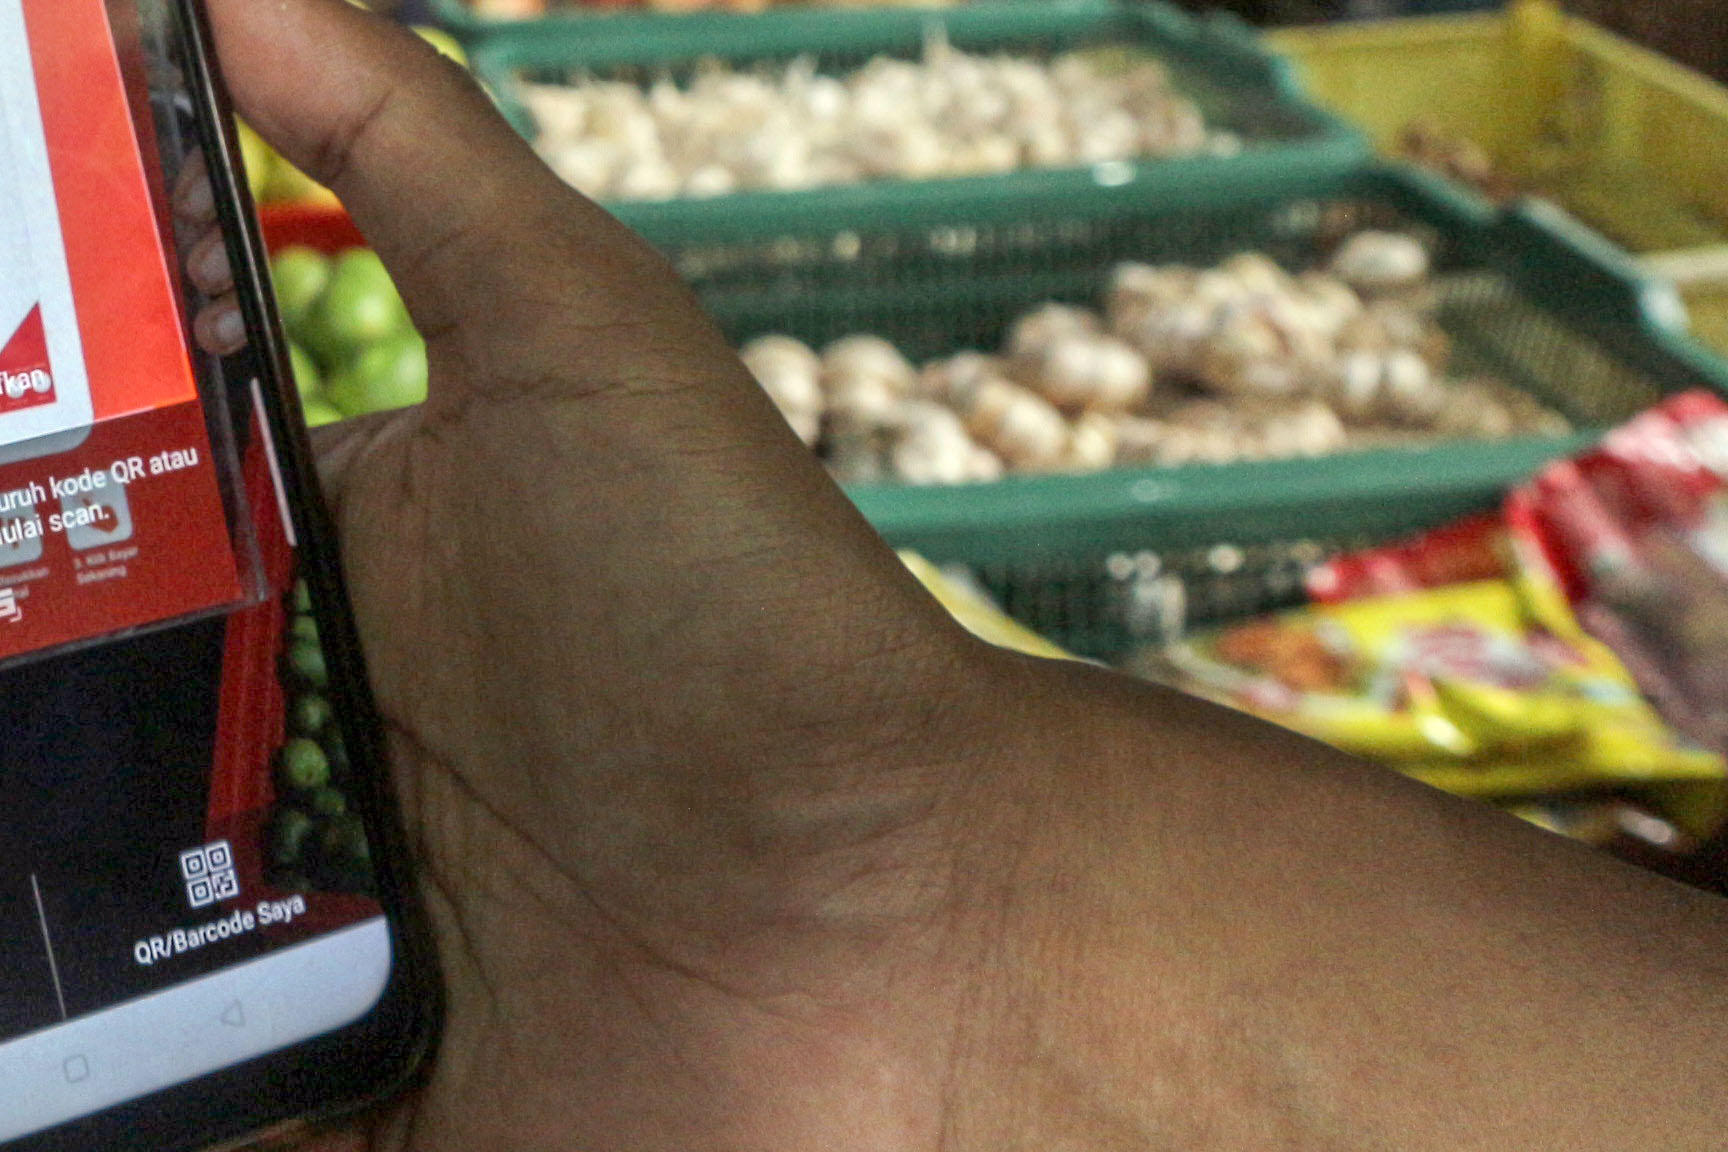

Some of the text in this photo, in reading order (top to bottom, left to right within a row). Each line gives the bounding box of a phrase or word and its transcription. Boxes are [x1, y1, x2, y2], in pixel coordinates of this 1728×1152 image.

[51, 465, 106, 502] kode
[111, 457, 146, 489] QR
[149, 445, 199, 476] atau
[48, 501, 111, 532] scan.
[133, 892, 306, 966] QR/Barcode Saya
